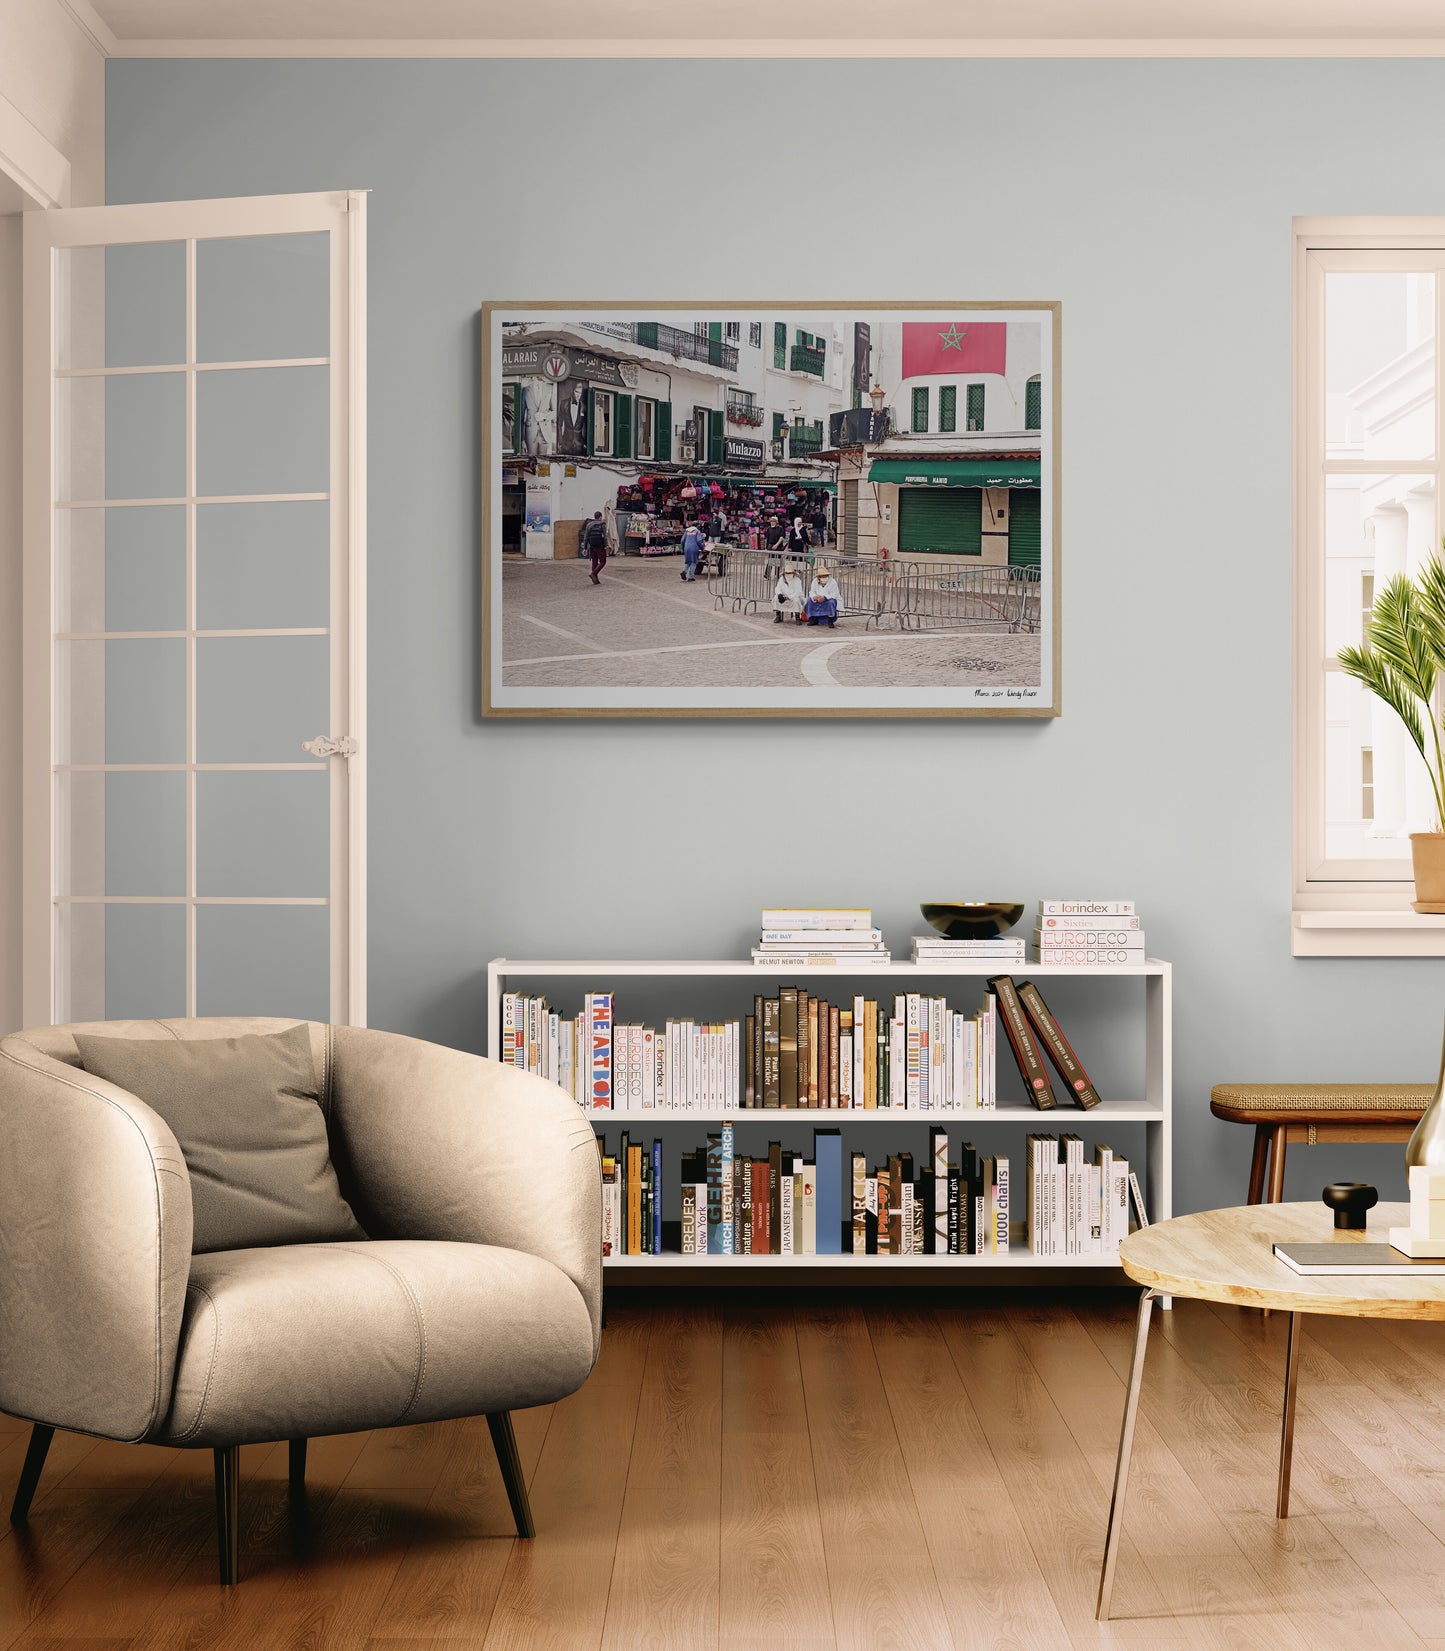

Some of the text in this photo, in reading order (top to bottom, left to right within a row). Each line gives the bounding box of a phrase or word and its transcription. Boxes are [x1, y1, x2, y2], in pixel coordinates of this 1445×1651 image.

[503, 352, 538, 364] AL ARAIS
[728, 442, 762, 458] Mulazzo
[1048, 904, 1108, 912] colorindex
[1044, 933, 1128, 944] EURODECO
[1044, 951, 1128, 962] EURODECO
[593, 996, 610, 1108] THE ART BOOK
[617, 1029, 626, 1096] EURODECO
[632, 1029, 641, 1096] EURODECO
[1066, 1059, 1075, 1071] JAPAN
[773, 1073, 778, 1082] M.
[708, 1137, 722, 1224] GEHRY
[742, 1162, 751, 1209] Subnature
[684, 1197, 694, 1253] BREUER
[697, 1206, 706, 1253] New York
[723, 1162, 733, 1255] ARCHITECTURE
[878, 1185, 888, 1233] PIN-UP
[902, 1186, 912, 1254] Scandinavian
[914, 1200, 923, 1254] PICASSO
[950, 1206, 958, 1225] Lloyd
[997, 1170, 1008, 1244] 1000 chairs
